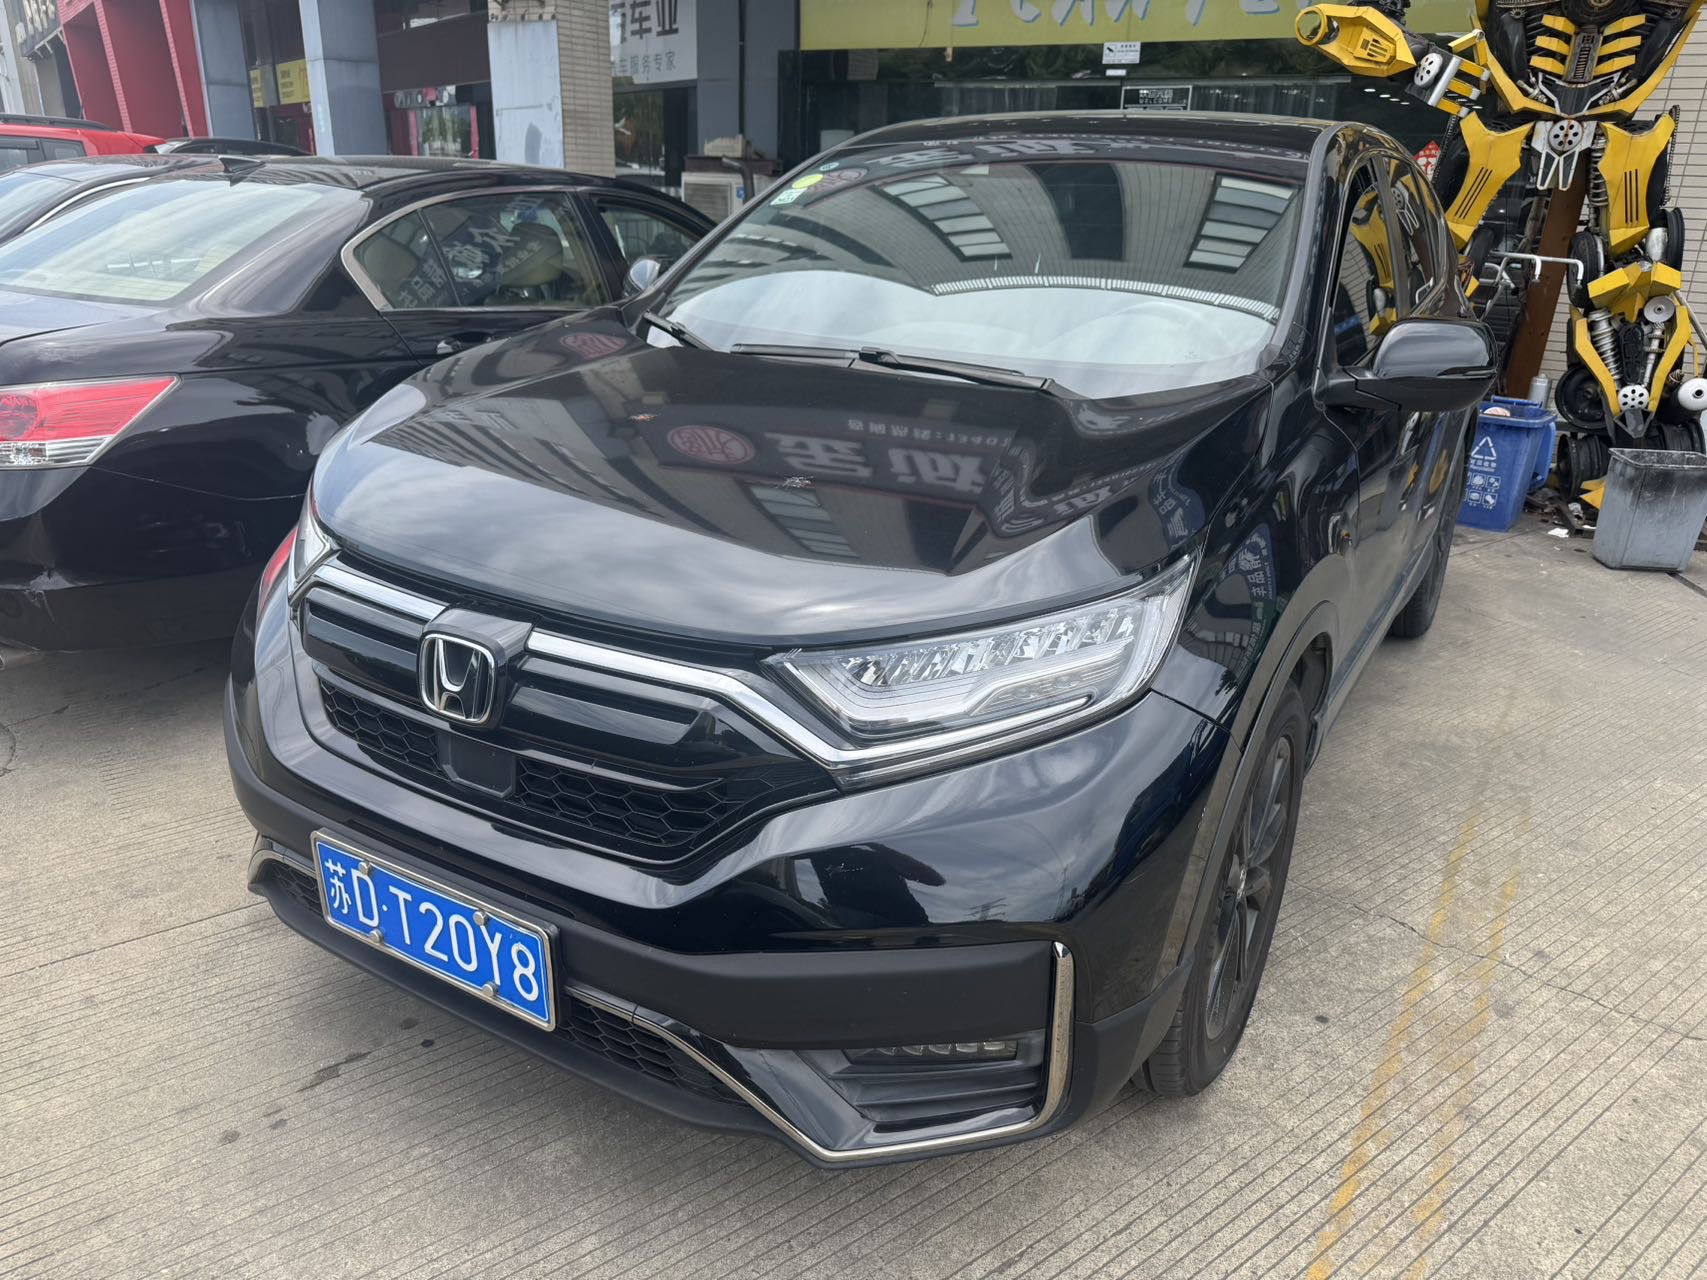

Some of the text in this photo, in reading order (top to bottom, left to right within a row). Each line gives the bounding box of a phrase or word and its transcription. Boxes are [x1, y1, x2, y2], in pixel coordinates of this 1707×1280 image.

[612, 51, 676, 77] 车服务专家
[324, 857, 540, 1002] 苏D·T20Y8
